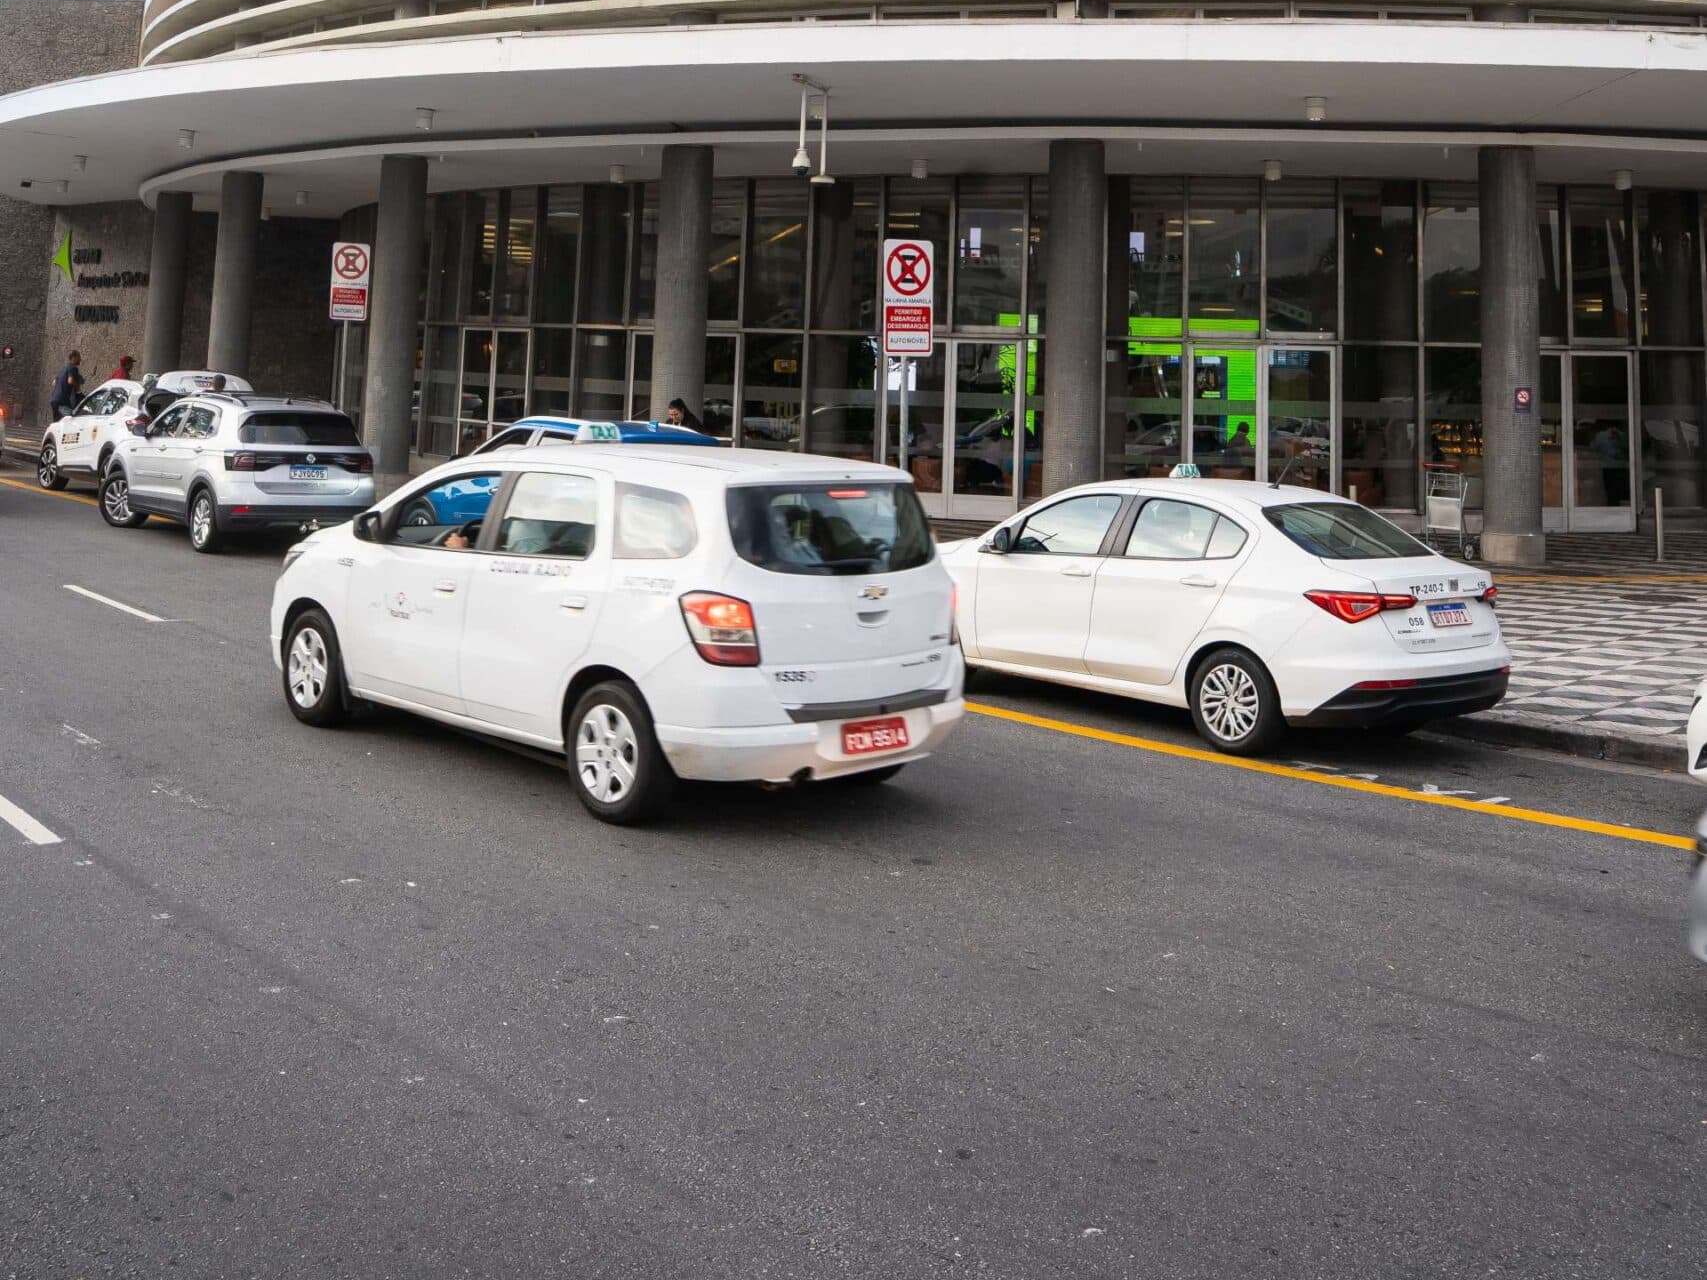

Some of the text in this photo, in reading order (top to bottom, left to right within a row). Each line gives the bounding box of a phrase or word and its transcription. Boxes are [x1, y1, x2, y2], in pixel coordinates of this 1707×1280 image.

[895, 308, 923, 316] PERMITIDO
[1409, 583, 1444, 595] TP-240-2
[1408, 616, 1425, 627] 058
